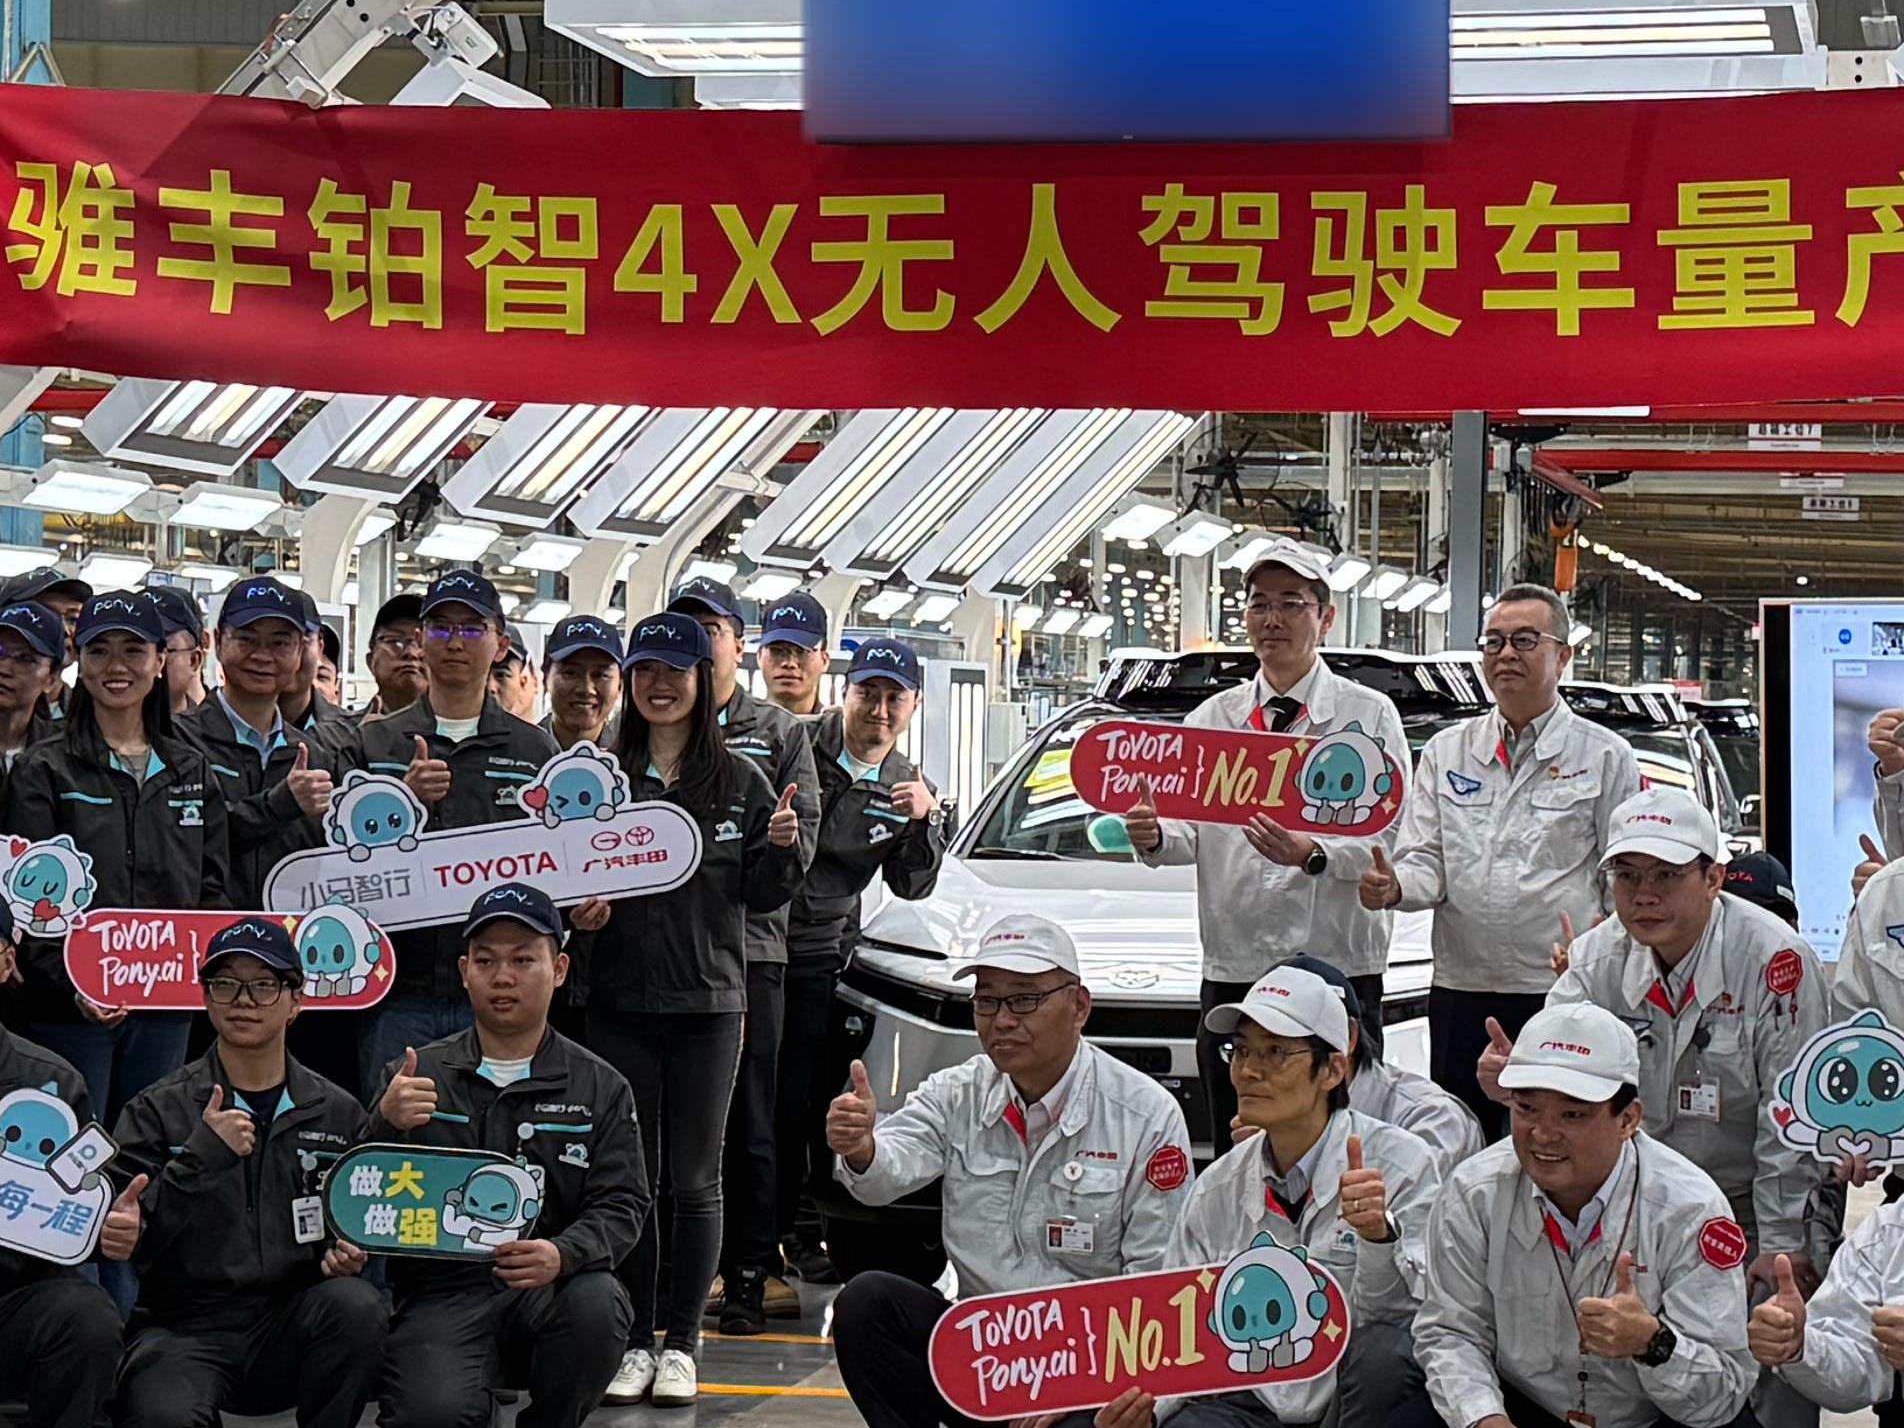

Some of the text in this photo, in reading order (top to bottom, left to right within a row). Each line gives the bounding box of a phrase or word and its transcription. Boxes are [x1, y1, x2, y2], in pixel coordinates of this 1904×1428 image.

[1202, 747, 1294, 809] No.1
[433, 851, 559, 889] TOYOTA
[582, 848, 669, 873] 广汽丰田
[300, 867, 412, 911] 小马智行
[97, 953, 185, 997] Pony.ai
[348, 1160, 425, 1201] 做大
[363, 1203, 438, 1247] 做强
[1104, 1283, 1206, 1384] No.1
[970, 1337, 1078, 1408] Pony.ai
